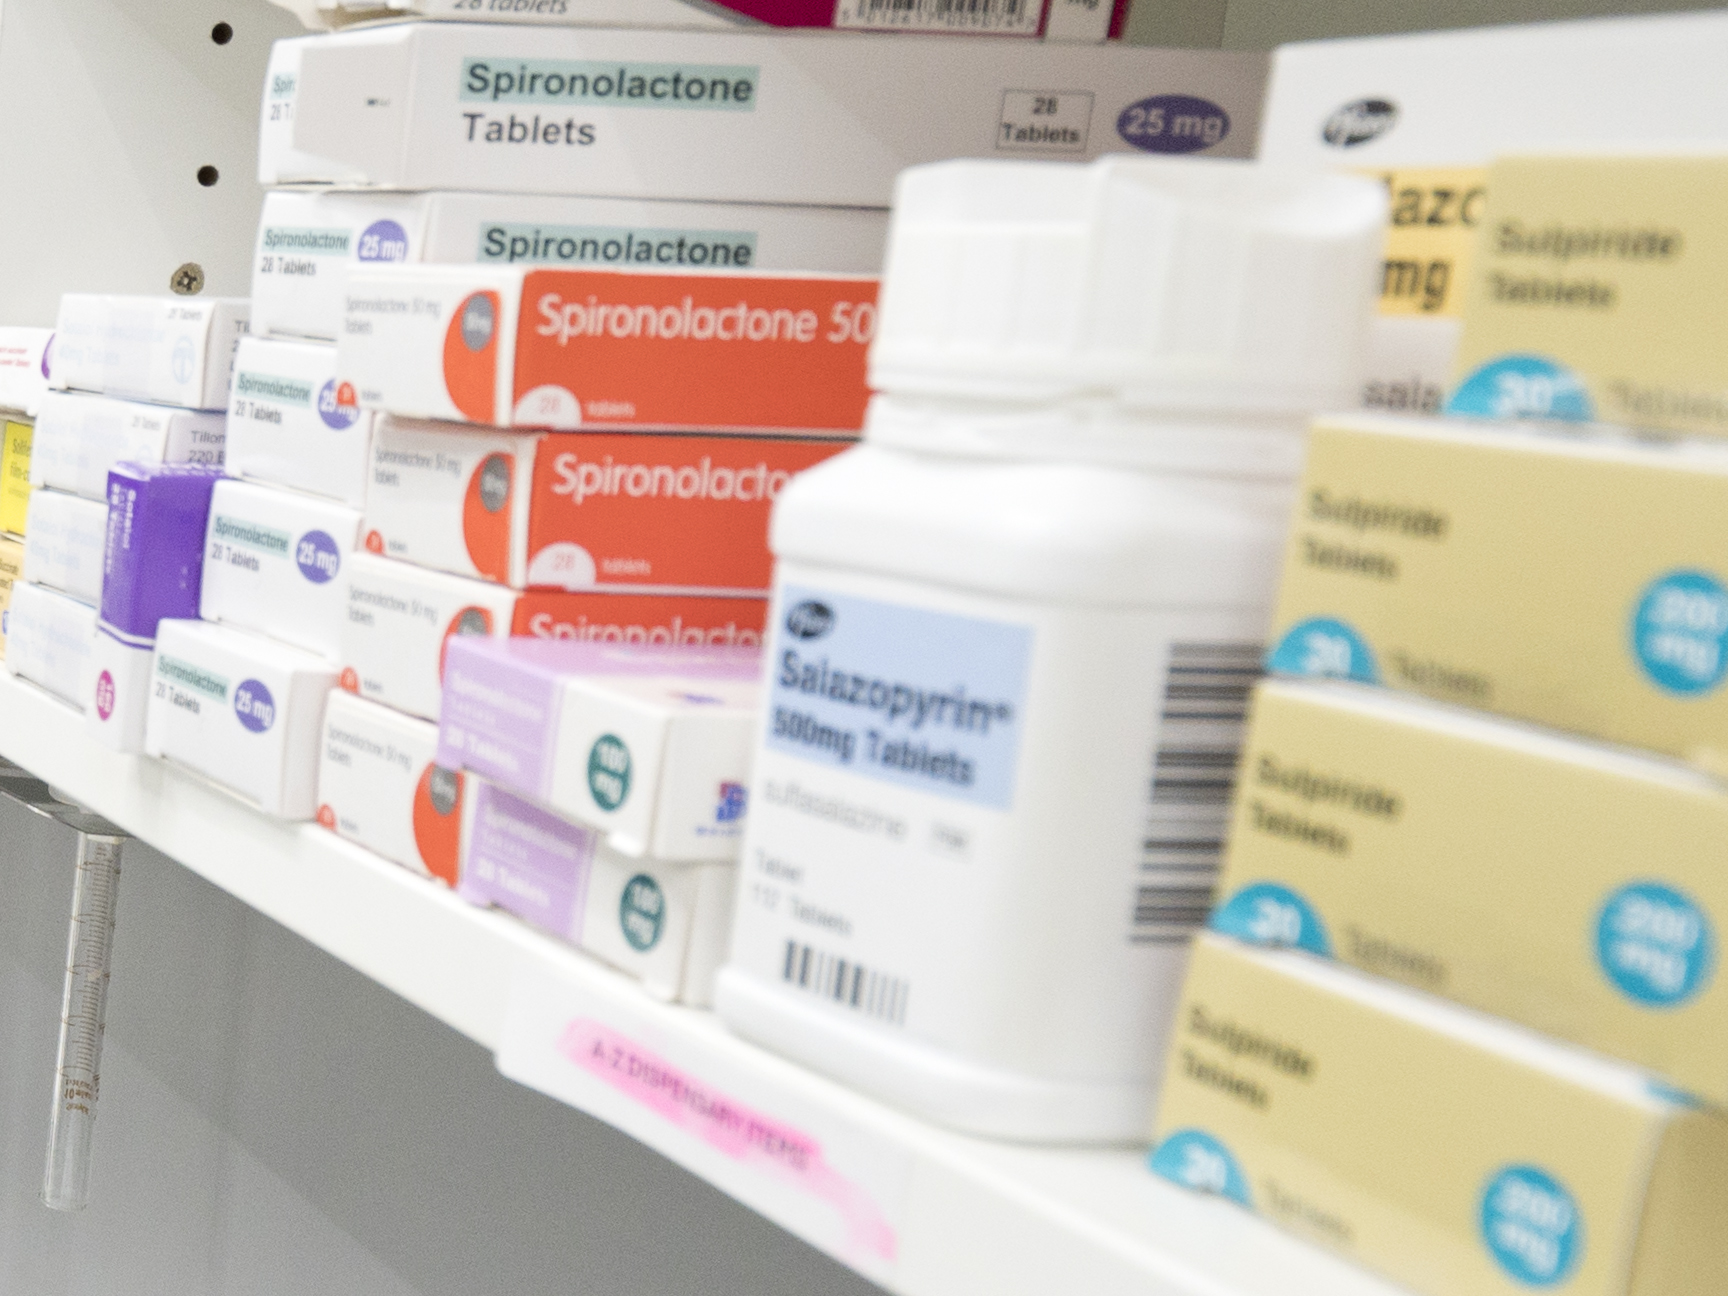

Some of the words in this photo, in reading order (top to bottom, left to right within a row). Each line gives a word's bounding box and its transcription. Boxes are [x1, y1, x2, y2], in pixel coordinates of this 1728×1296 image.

[466, 61, 754, 106] Spironolactone
[1032, 97, 1058, 115] 28
[462, 113, 597, 145] Tablets
[1002, 121, 1080, 144] Tablets
[1124, 110, 1165, 136] 25
[1172, 114, 1225, 143] mg
[265, 230, 350, 254] Spironolactone
[359, 236, 379, 257] 25
[381, 241, 407, 262] mg
[485, 229, 753, 266] Spironolactone
[277, 257, 317, 277] Tablets
[538, 294, 817, 347] Spironolactone
[830, 301, 878, 344] 50
[237, 376, 311, 402] Spironolactone
[215, 516, 290, 553] Spironolactone
[226, 546, 260, 572] Tablets
[298, 541, 316, 566] 25
[317, 552, 339, 578] mg
[158, 656, 228, 699] Spironolactone
[236, 689, 254, 714] 25
[253, 702, 274, 729] mg
[773, 708, 855, 766] 500mg
[863, 725, 975, 788] Tablets
